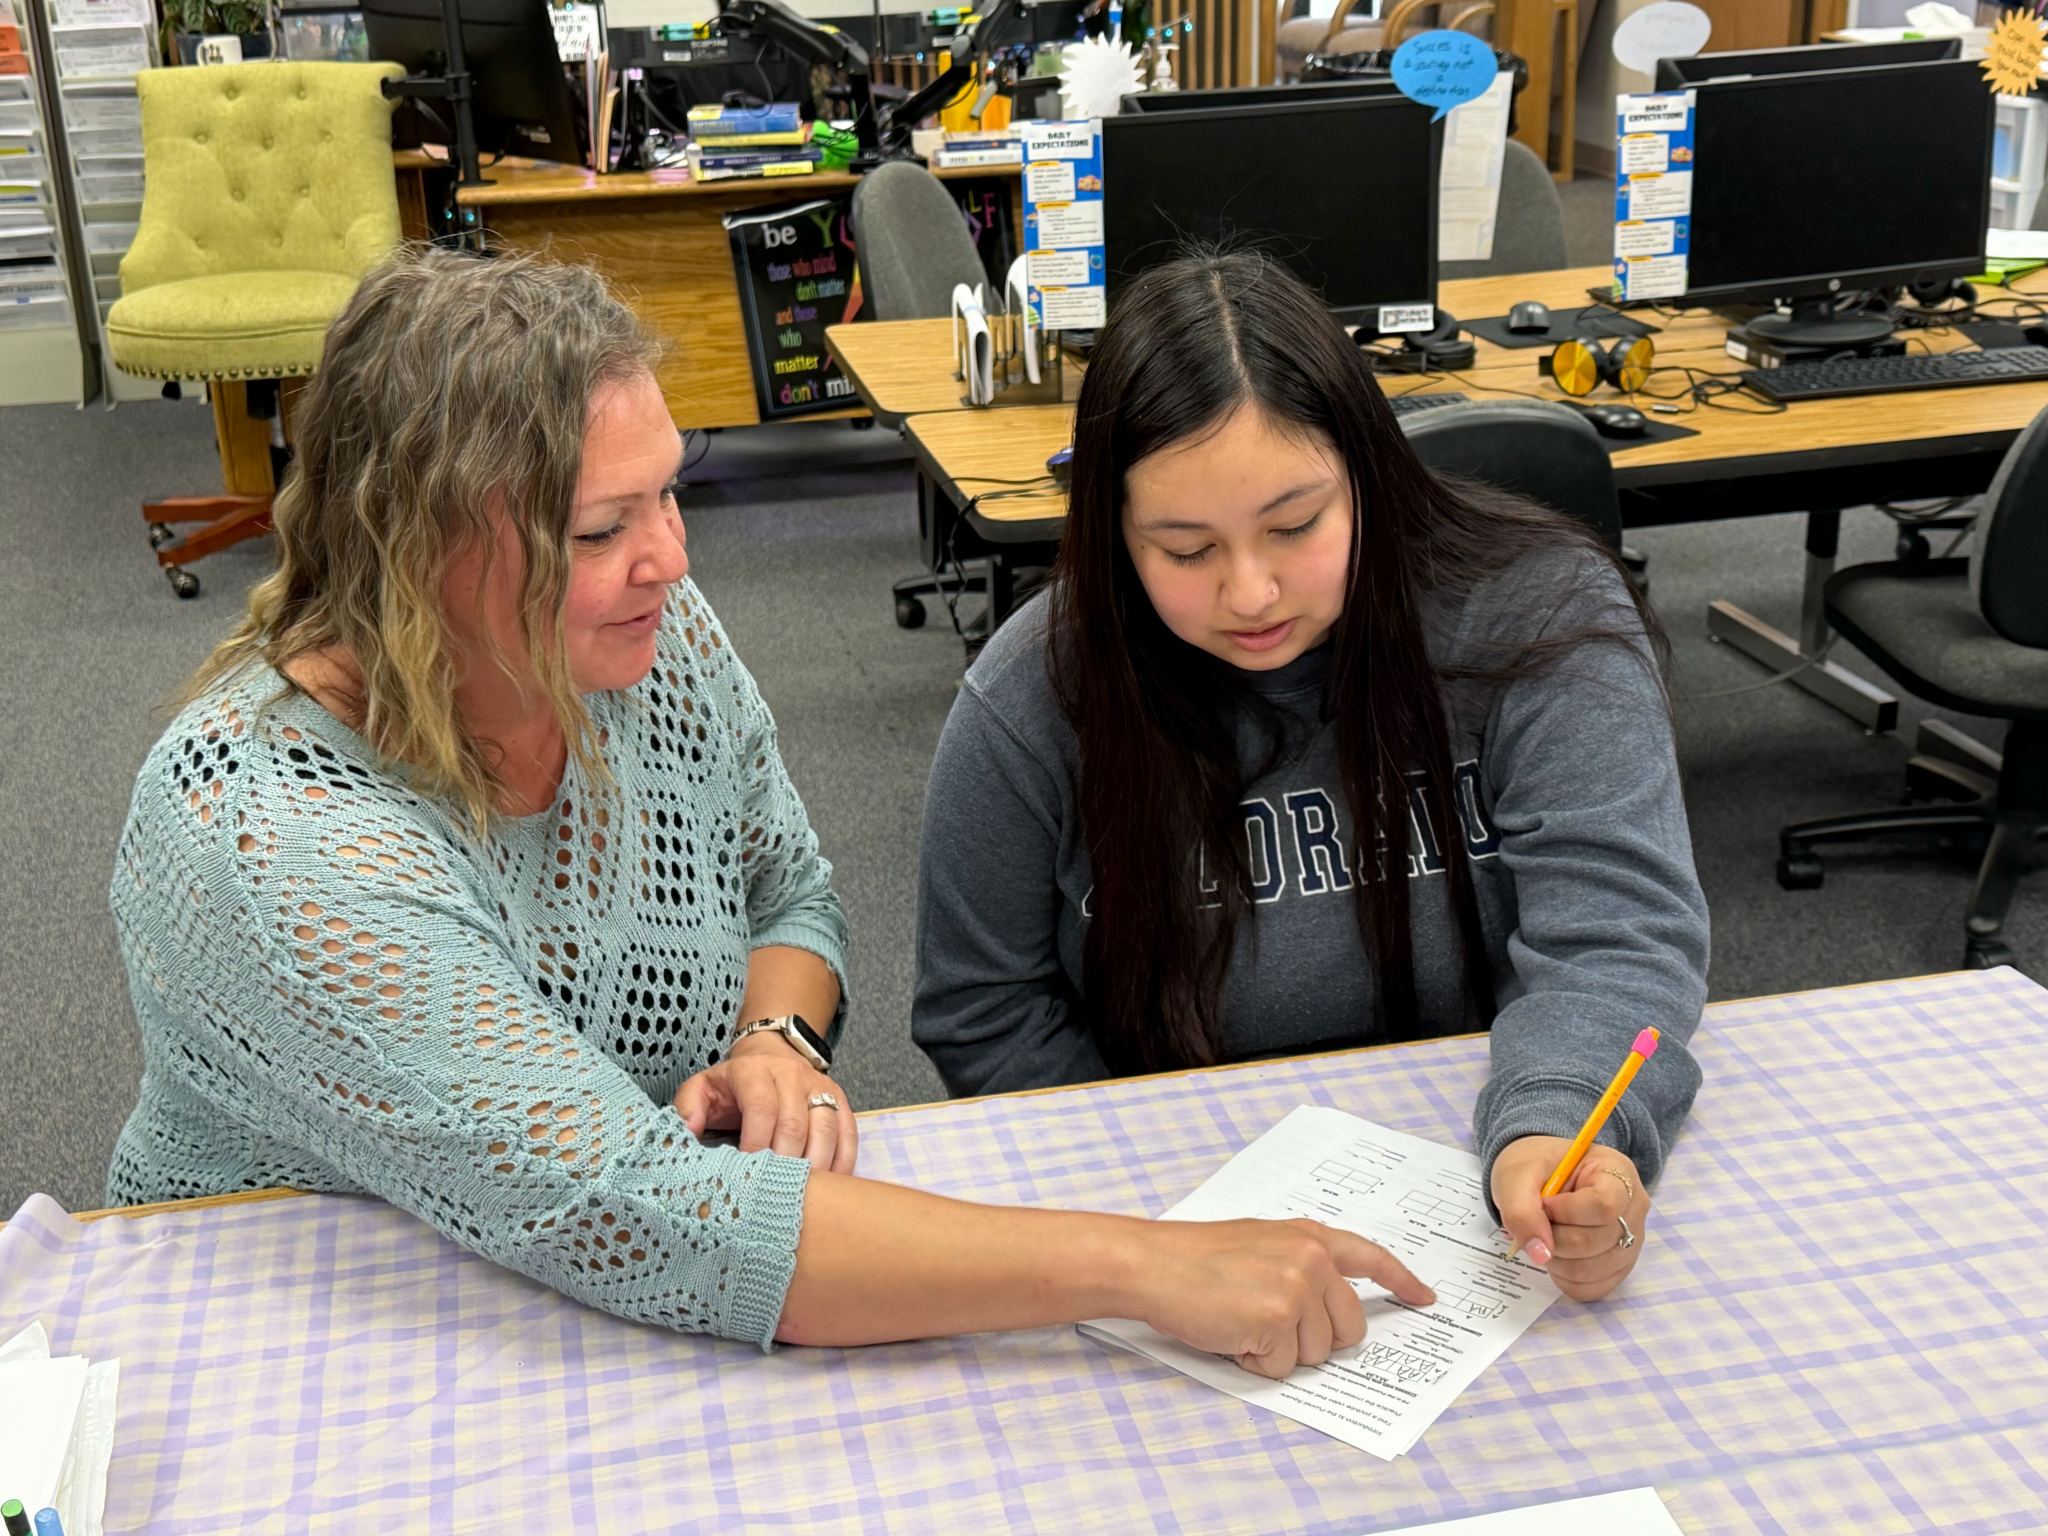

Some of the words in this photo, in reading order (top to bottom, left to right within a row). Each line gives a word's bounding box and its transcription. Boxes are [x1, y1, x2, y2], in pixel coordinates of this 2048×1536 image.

[1628, 112, 1683, 123] EXPECTATIONS
[1645, 104, 1669, 112] DAILY
[1032, 139, 1088, 150] EXPECTATIONS
[1048, 131, 1071, 140] DAILY
[761, 223, 798, 249] be
[792, 257, 812, 278] who
[775, 304, 794, 326] and
[777, 326, 803, 349] who
[773, 354, 819, 376] matter
[779, 378, 820, 405] don't
[825, 373, 856, 398] mi
